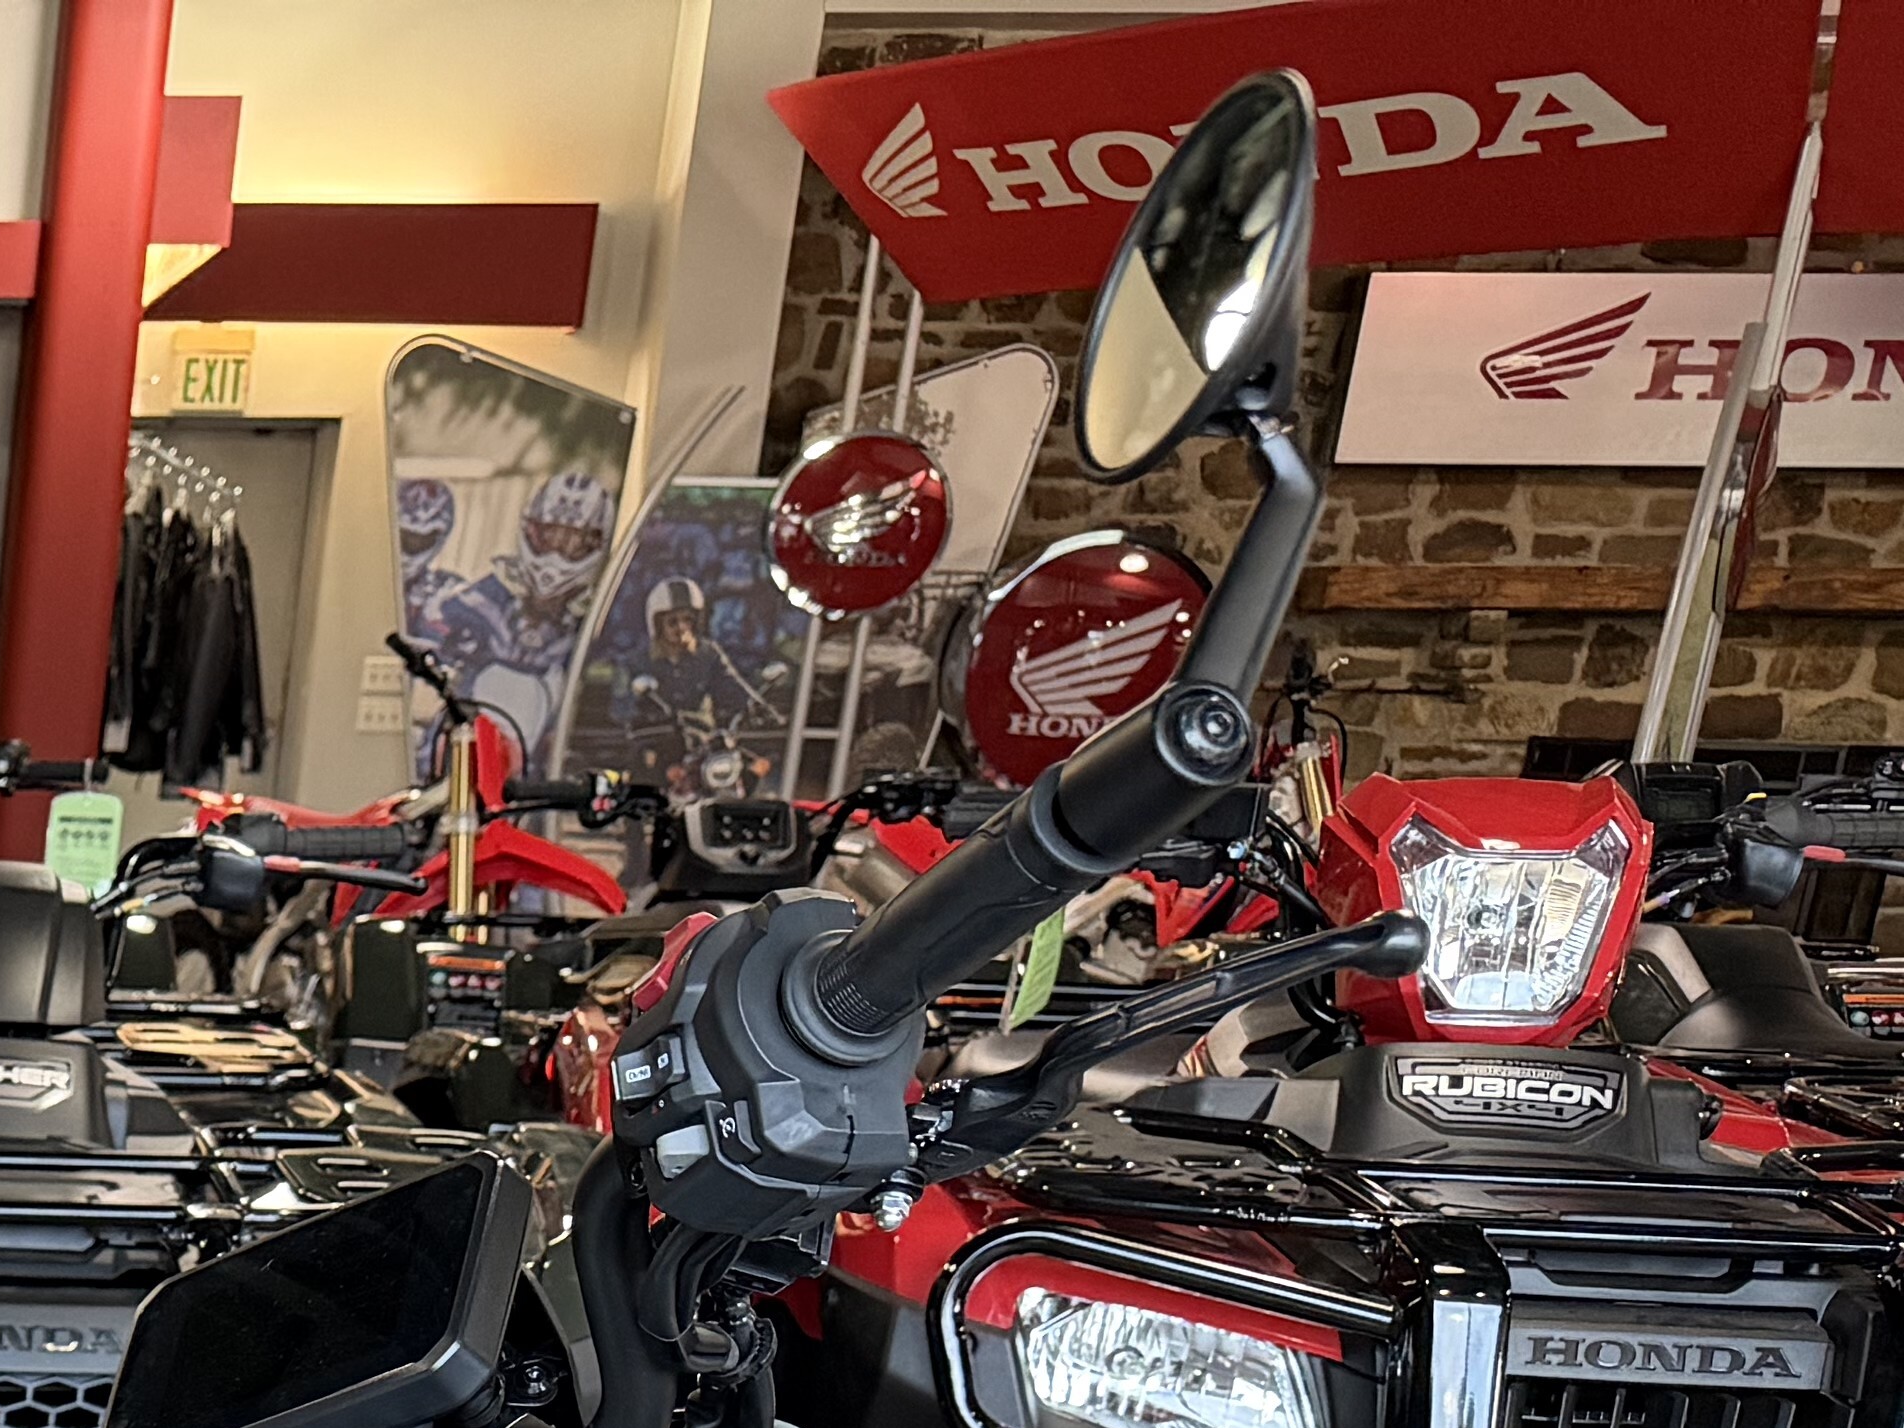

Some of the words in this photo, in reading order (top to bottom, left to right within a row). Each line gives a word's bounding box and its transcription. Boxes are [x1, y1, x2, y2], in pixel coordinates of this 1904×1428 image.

[953, 72, 1668, 212] HODA
[182, 357, 246, 404] EXIT
[1401, 1074, 1615, 1110] RUBICON
[1523, 1336, 1803, 1379] HONDA
